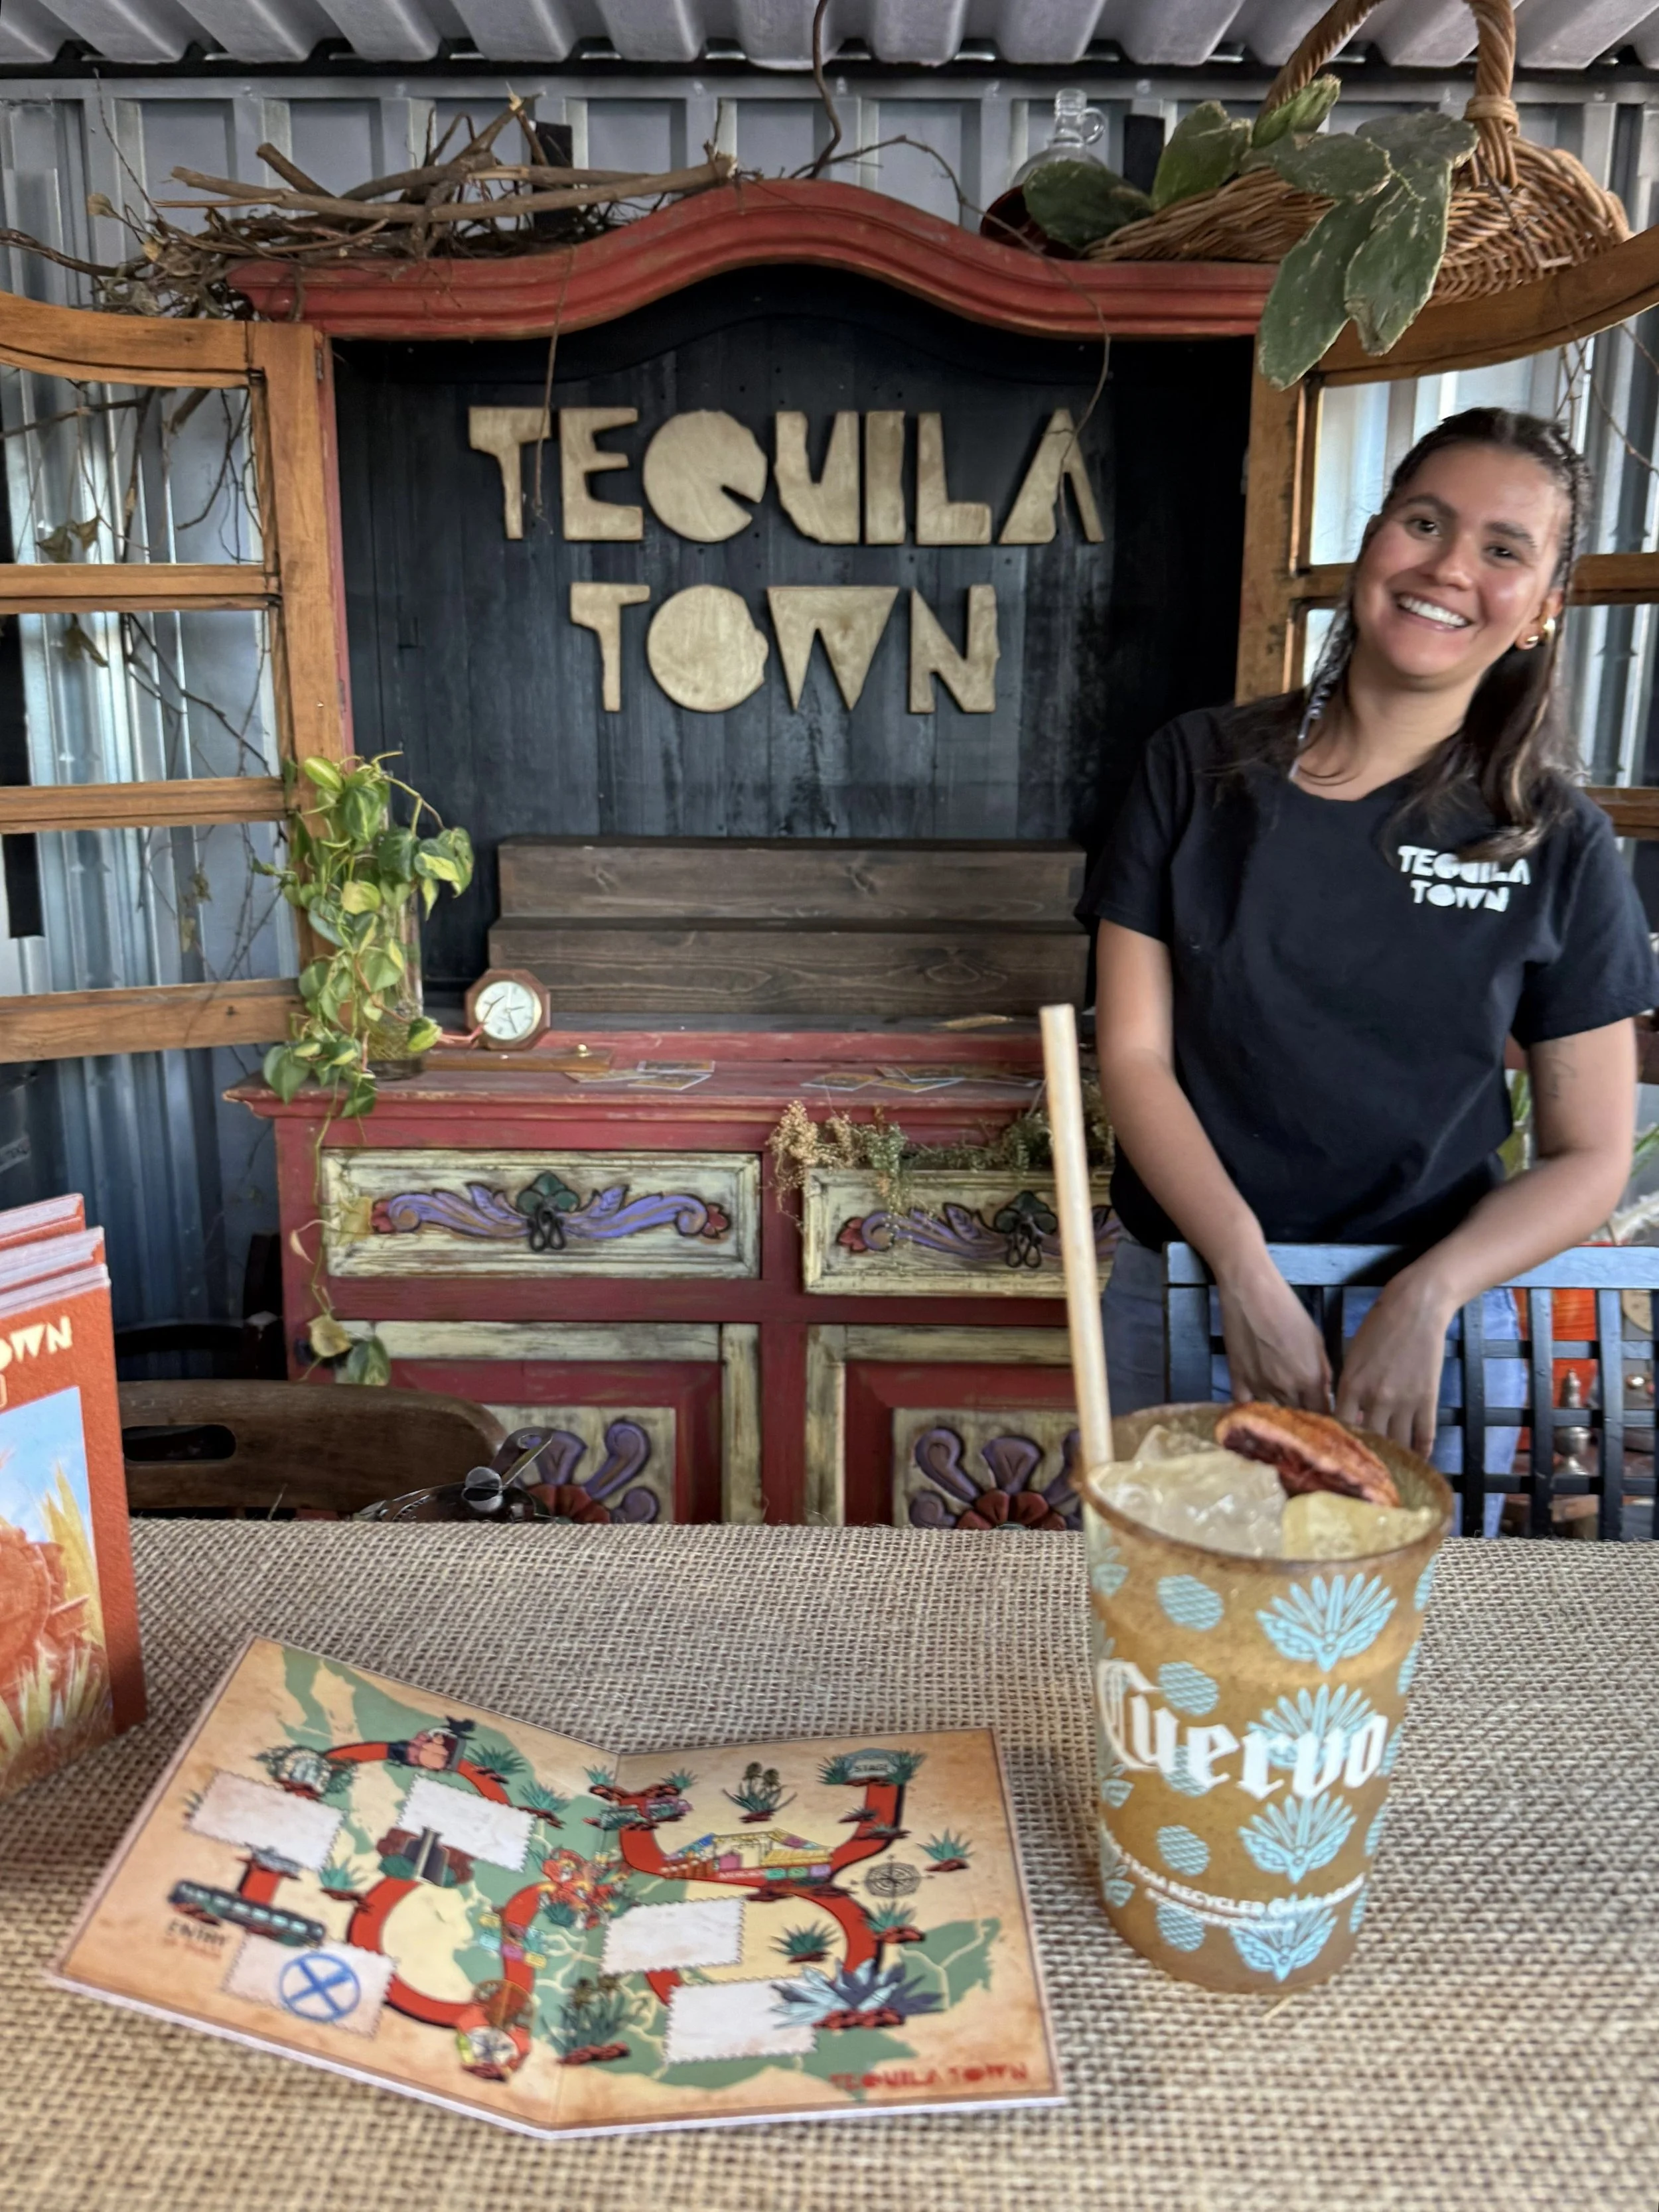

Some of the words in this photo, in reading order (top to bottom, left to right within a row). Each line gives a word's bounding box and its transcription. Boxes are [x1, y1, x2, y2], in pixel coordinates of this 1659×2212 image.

[469, 407, 1104, 545] TEQUILA
[570, 582, 1001, 714] TOWN
[1397, 845, 1531, 885] TEQUILA
[1410, 879, 1510, 912] TOWN
[1098, 1659, 1389, 1800] Cuervo
[830, 2066, 942, 2090] TEQUILA
[947, 2062, 1028, 2082] TOWN
